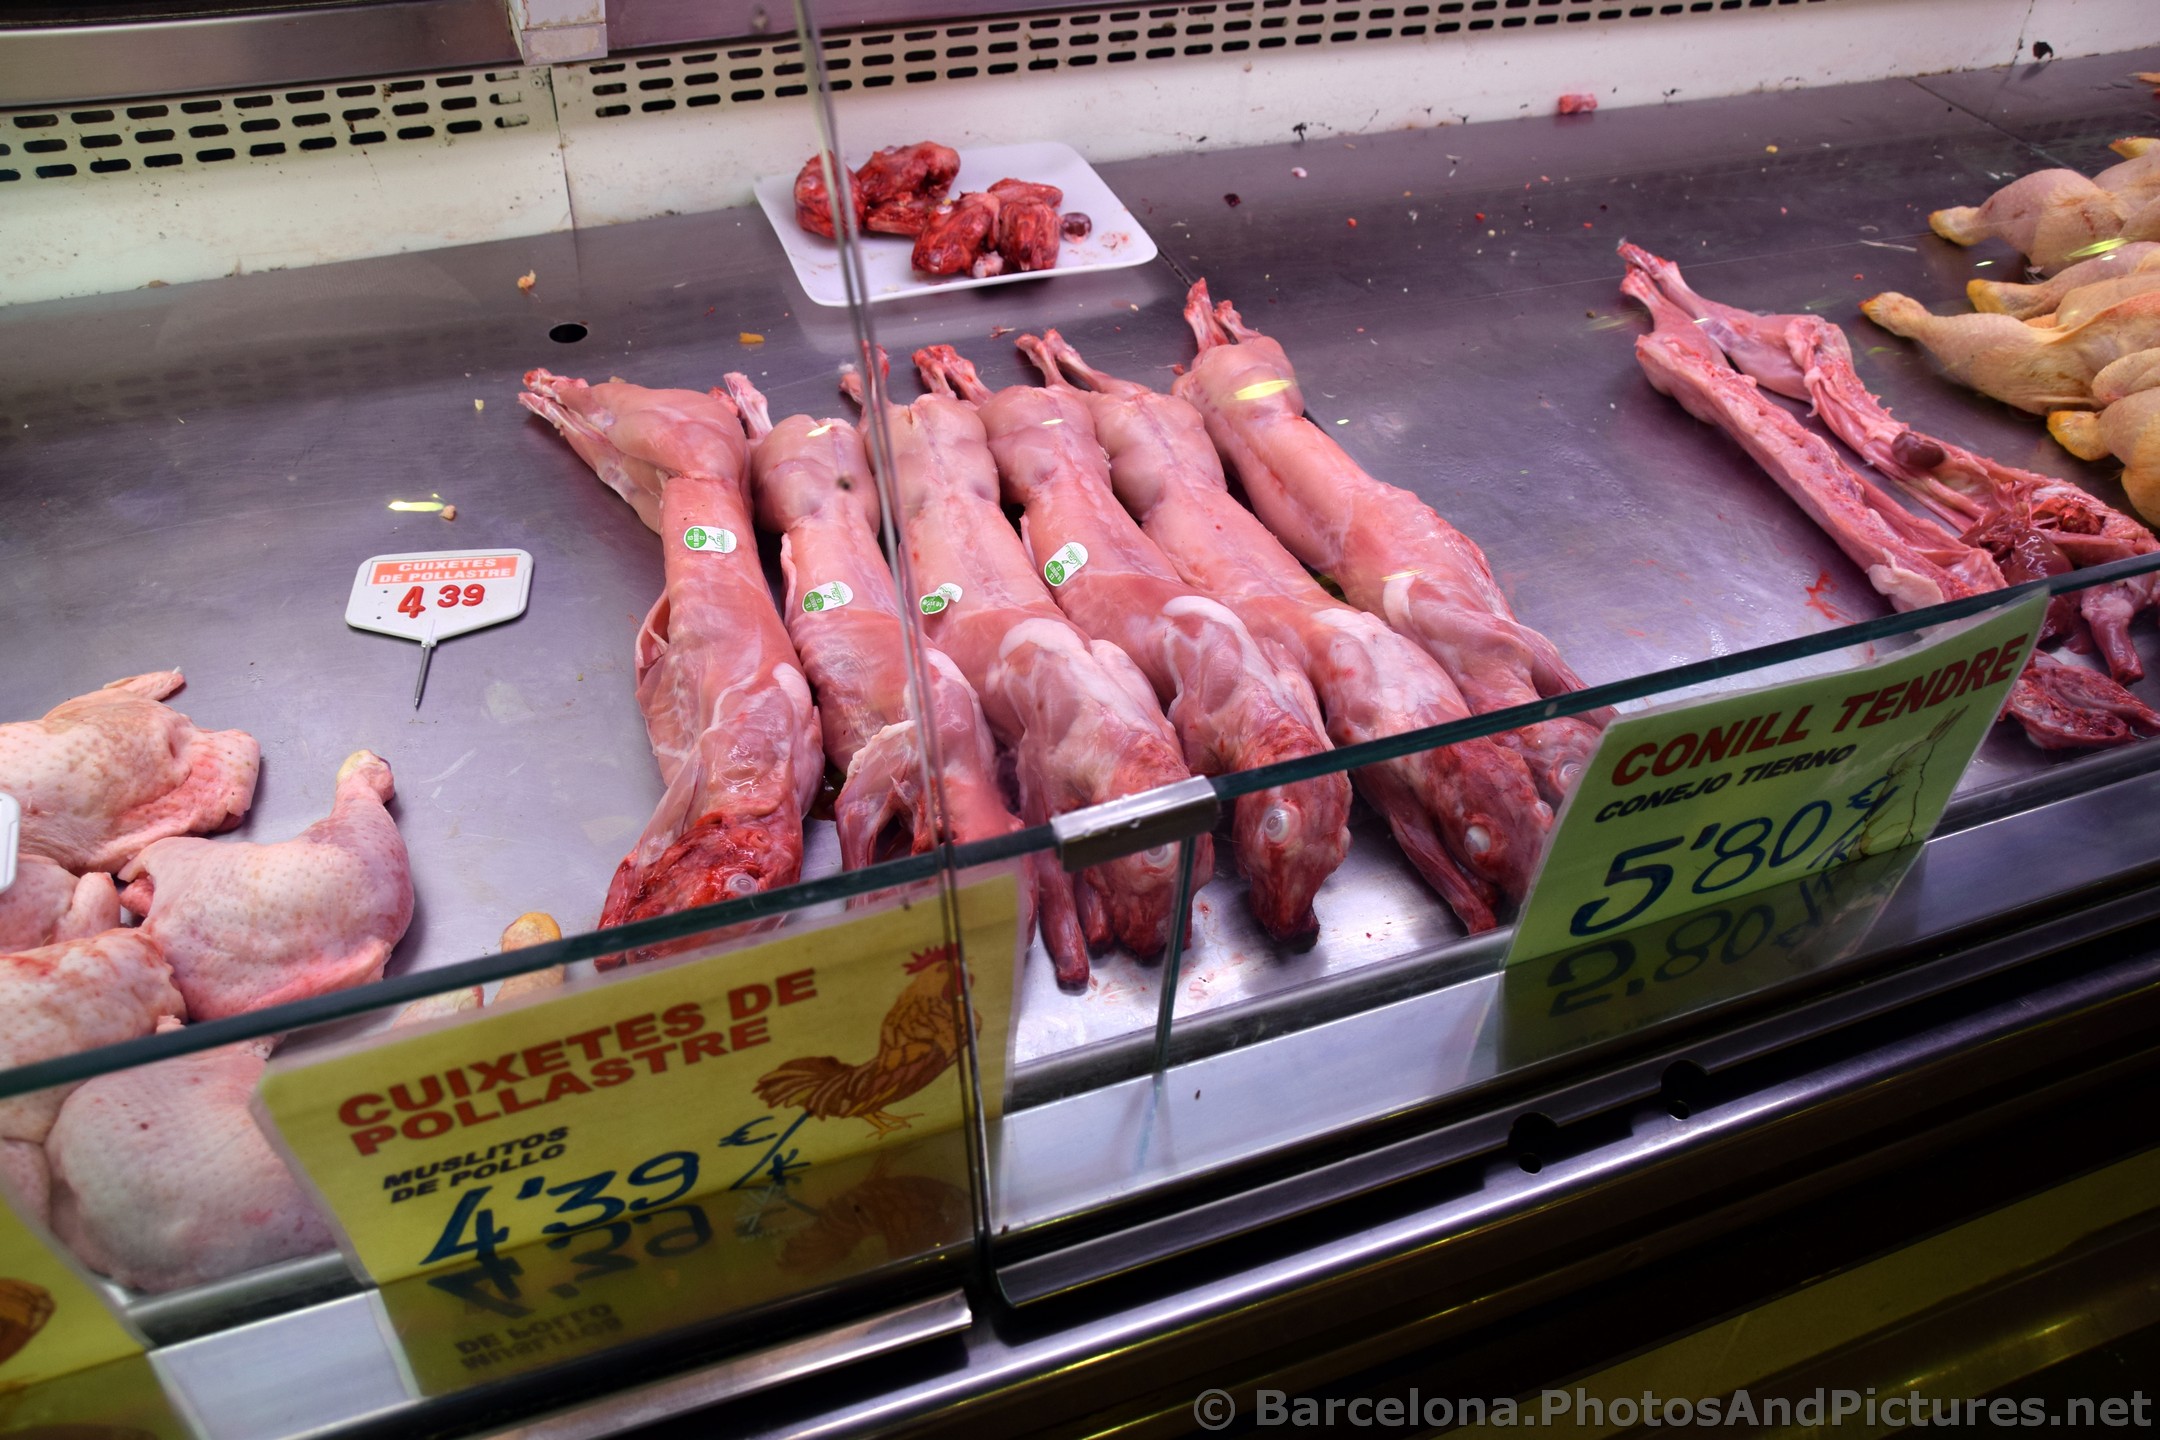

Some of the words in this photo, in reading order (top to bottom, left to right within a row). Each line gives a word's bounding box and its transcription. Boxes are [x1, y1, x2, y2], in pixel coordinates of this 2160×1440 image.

[379, 573, 402, 583] DE
[409, 568, 511, 582] POLLASTRE
[398, 559, 496, 572] CUIXETES
[397, 585, 426, 619] 4
[437, 583, 485, 608] 39
[1611, 704, 1816, 787] CONILL
[1833, 633, 2029, 733] TENDRE
[1594, 771, 1733, 823] CONEJO
[1737, 743, 1858, 787] TIERNO
[337, 1002, 706, 1128] CUIXETES
[727, 967, 818, 1020] DE
[350, 1016, 772, 1156] POLLASTRE
[383, 1126, 569, 1189] MUSLITOS
[390, 1179, 446, 1203] DE
[451, 1144, 567, 1187] POLLO
